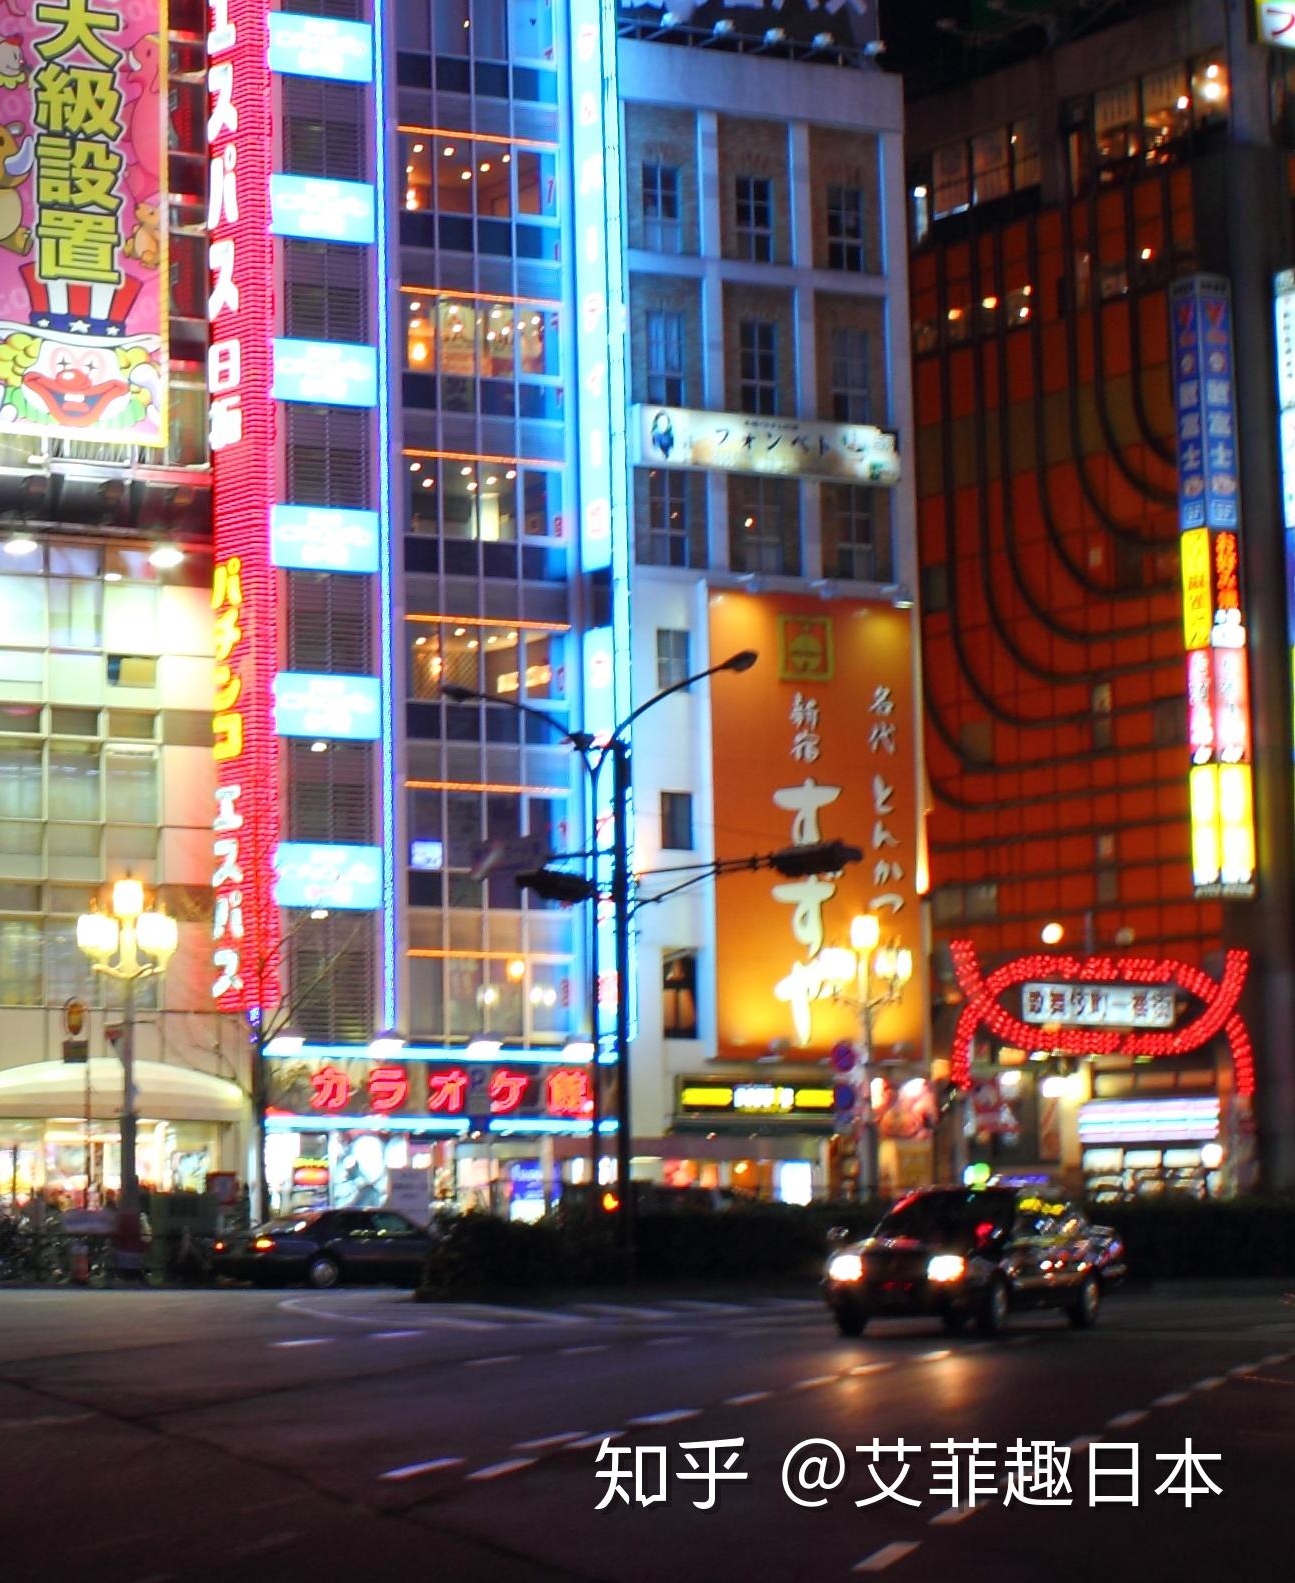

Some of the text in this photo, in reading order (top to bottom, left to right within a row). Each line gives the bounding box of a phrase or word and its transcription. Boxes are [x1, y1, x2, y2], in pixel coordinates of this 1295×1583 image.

[211, 557, 244, 999] パチンコ エスパス
[790, 691, 821, 764] 新宿
[869, 774, 905, 915] とんかつ
[309, 1064, 594, 1116] カラオケ館
